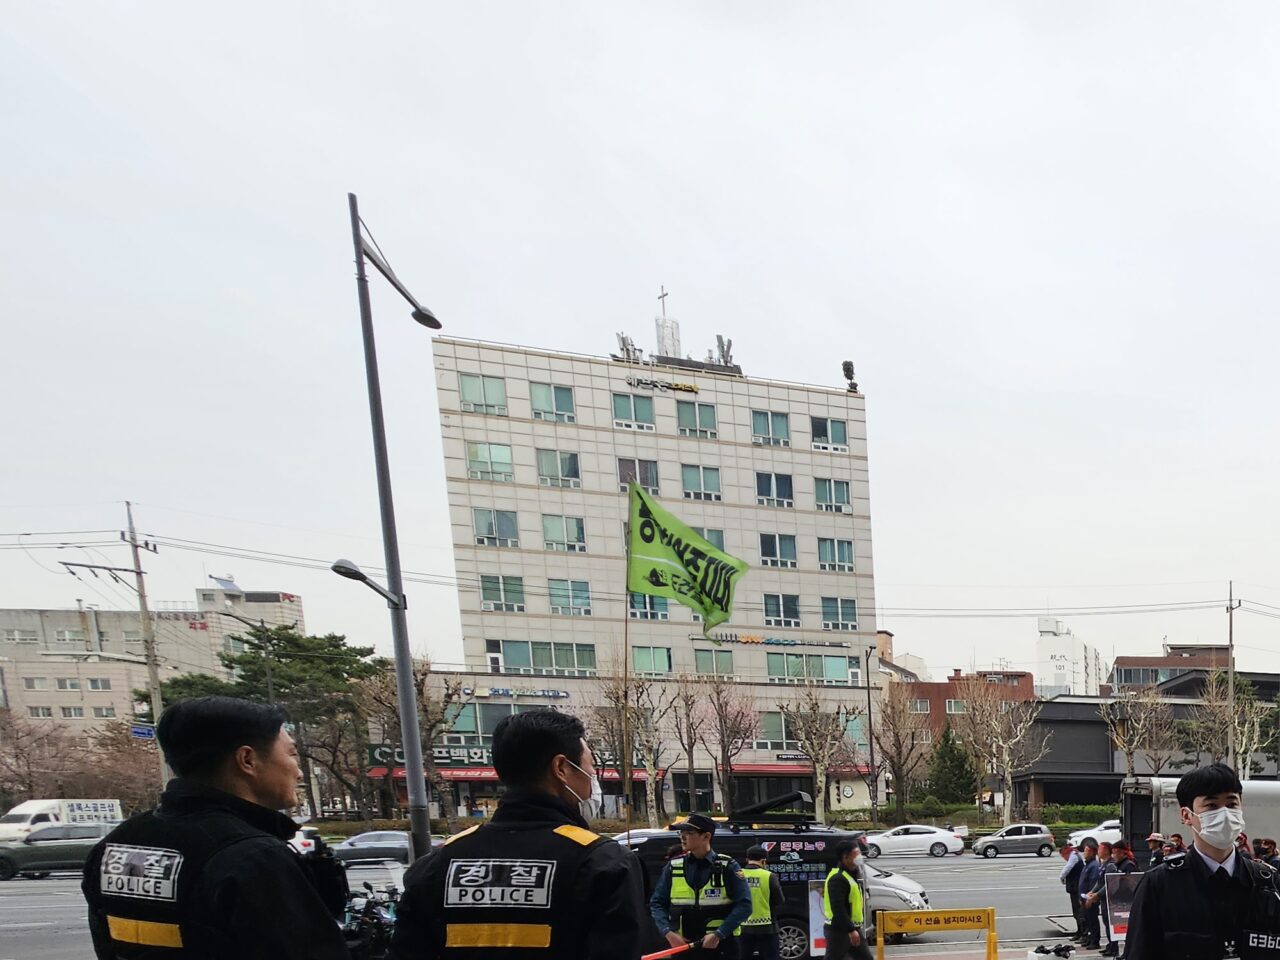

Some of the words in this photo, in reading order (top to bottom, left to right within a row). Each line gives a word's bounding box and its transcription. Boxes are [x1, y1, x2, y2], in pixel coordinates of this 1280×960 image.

[458, 865, 541, 886] 경찰
[106, 875, 163, 895] POLICE
[458, 888, 535, 902] POLICE
[914, 917, 922, 926] 이
[943, 915, 983, 925] 넘지마시오
